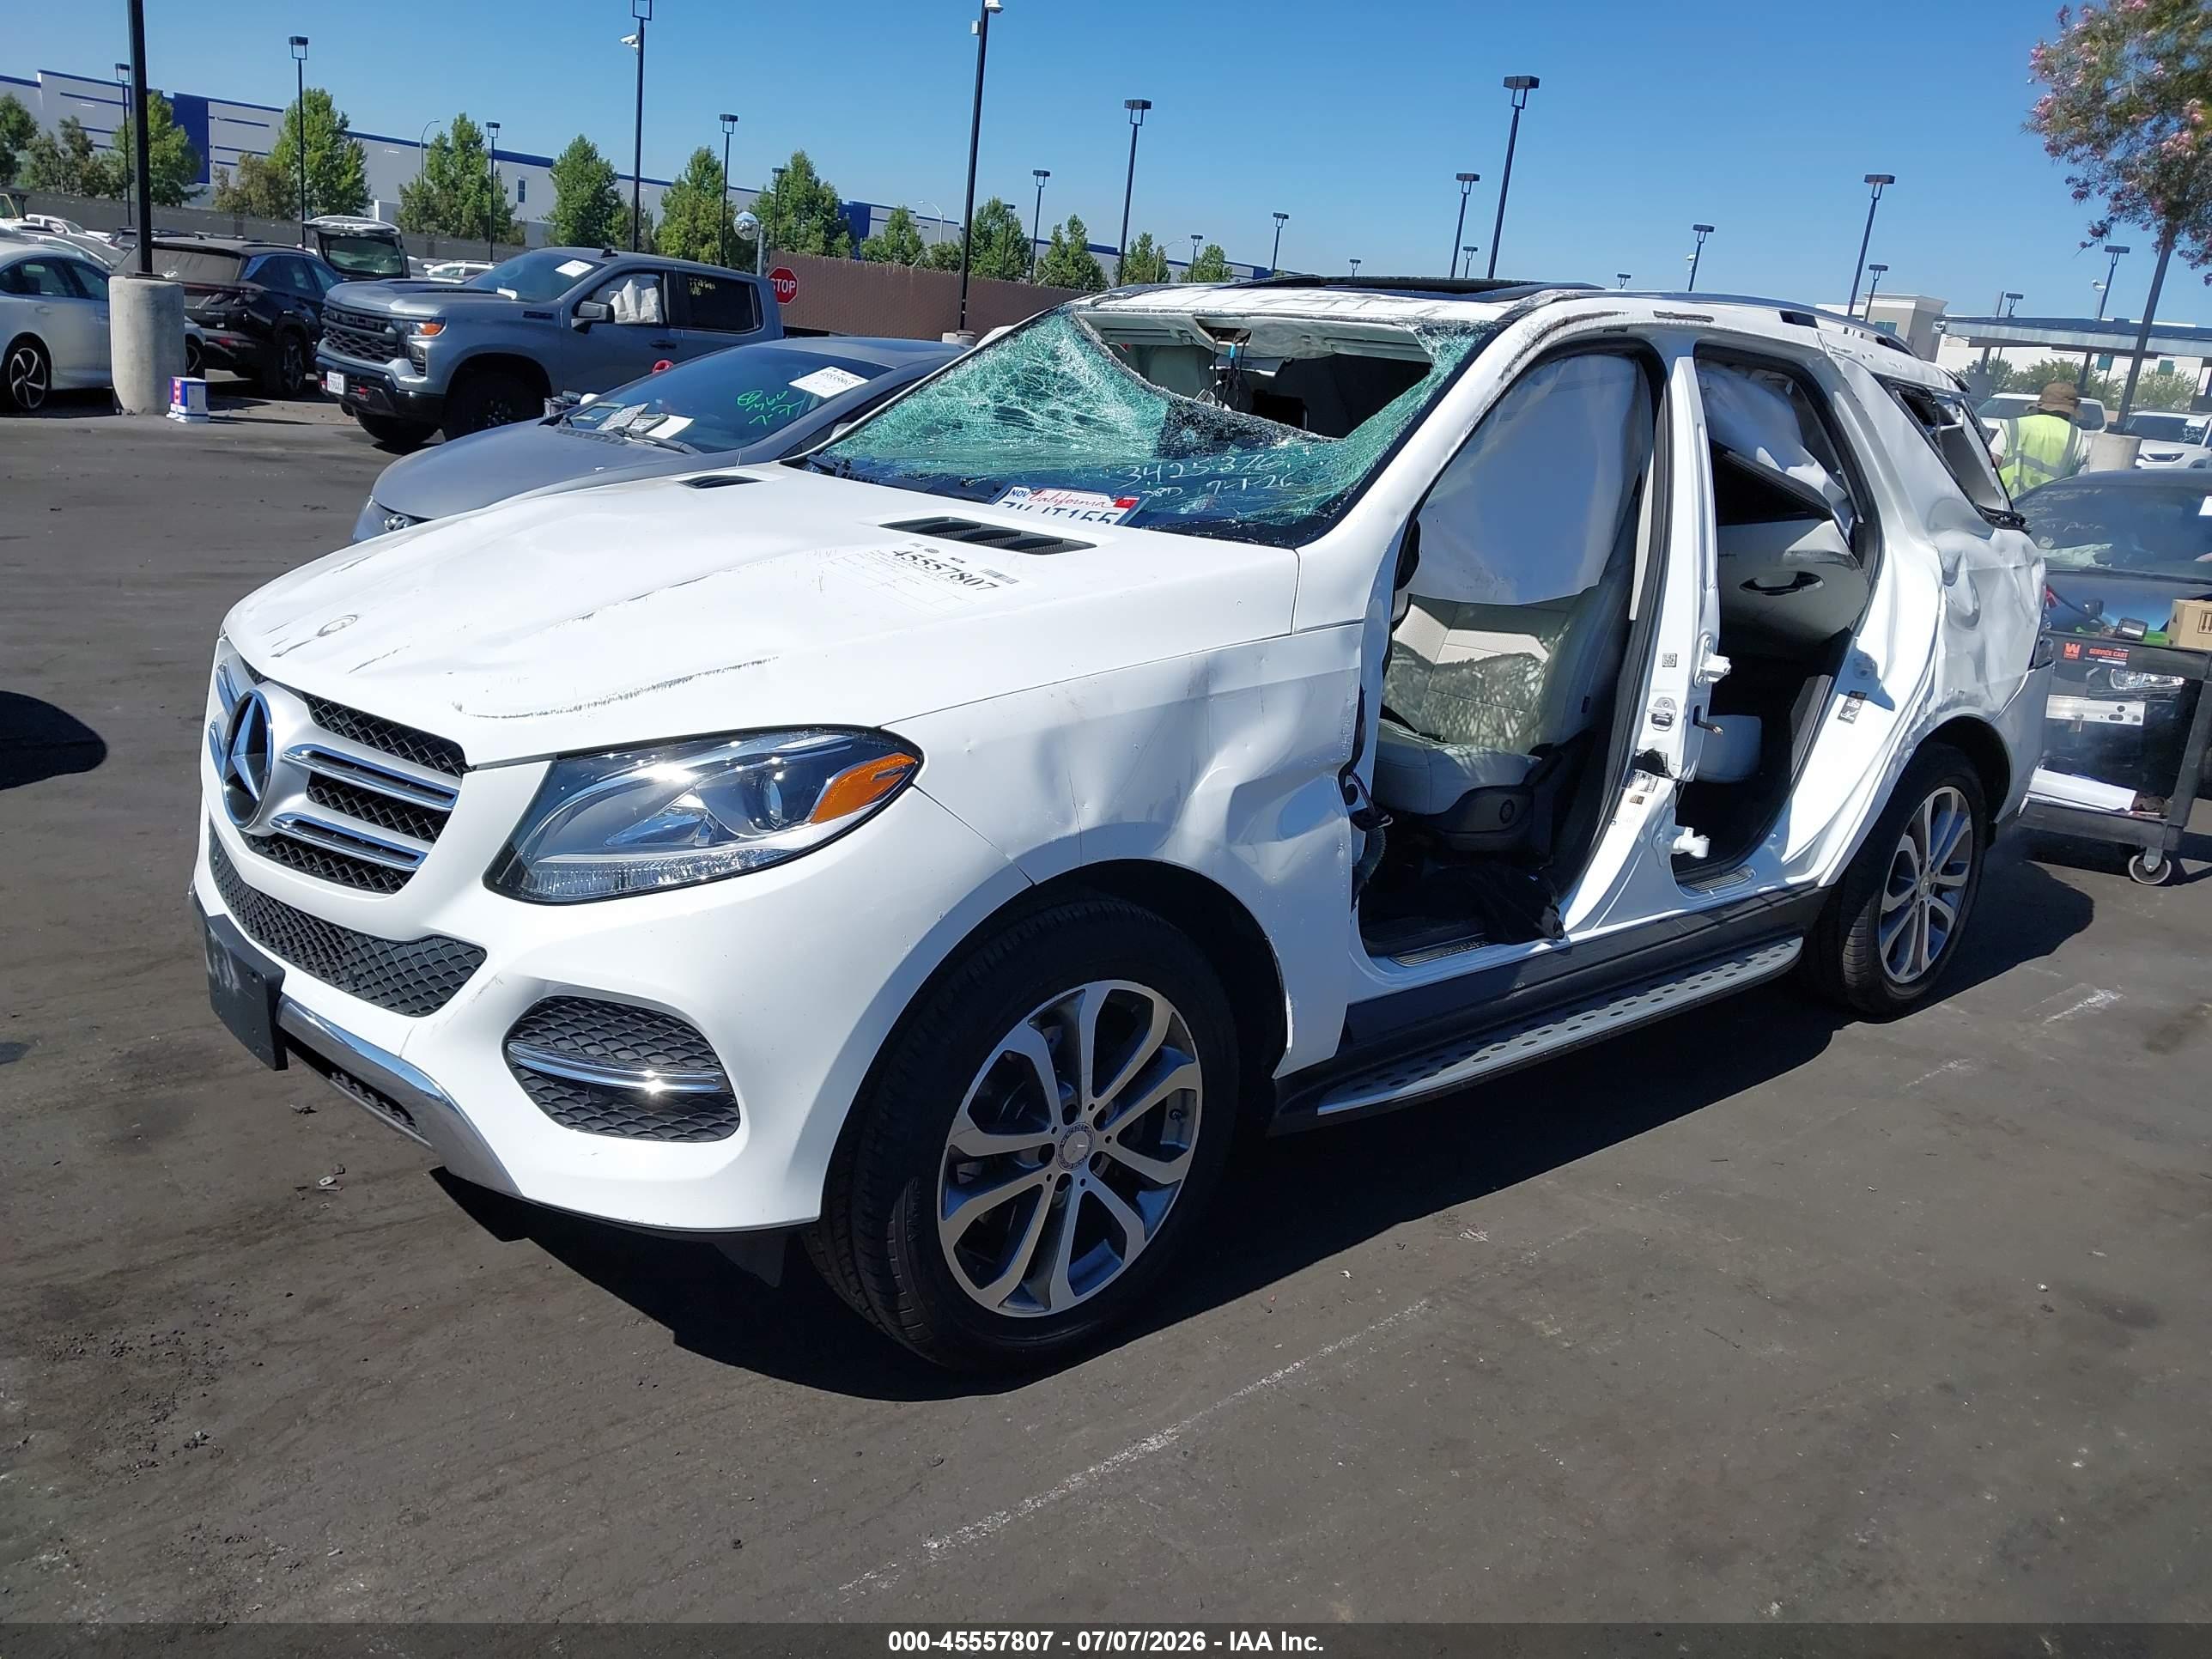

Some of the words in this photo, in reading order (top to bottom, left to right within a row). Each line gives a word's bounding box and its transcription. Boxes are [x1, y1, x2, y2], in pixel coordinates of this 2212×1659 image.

[1009, 488, 1030, 498] NOV
[1028, 490, 1114, 508] California
[893, 550, 1000, 591] 45557807
